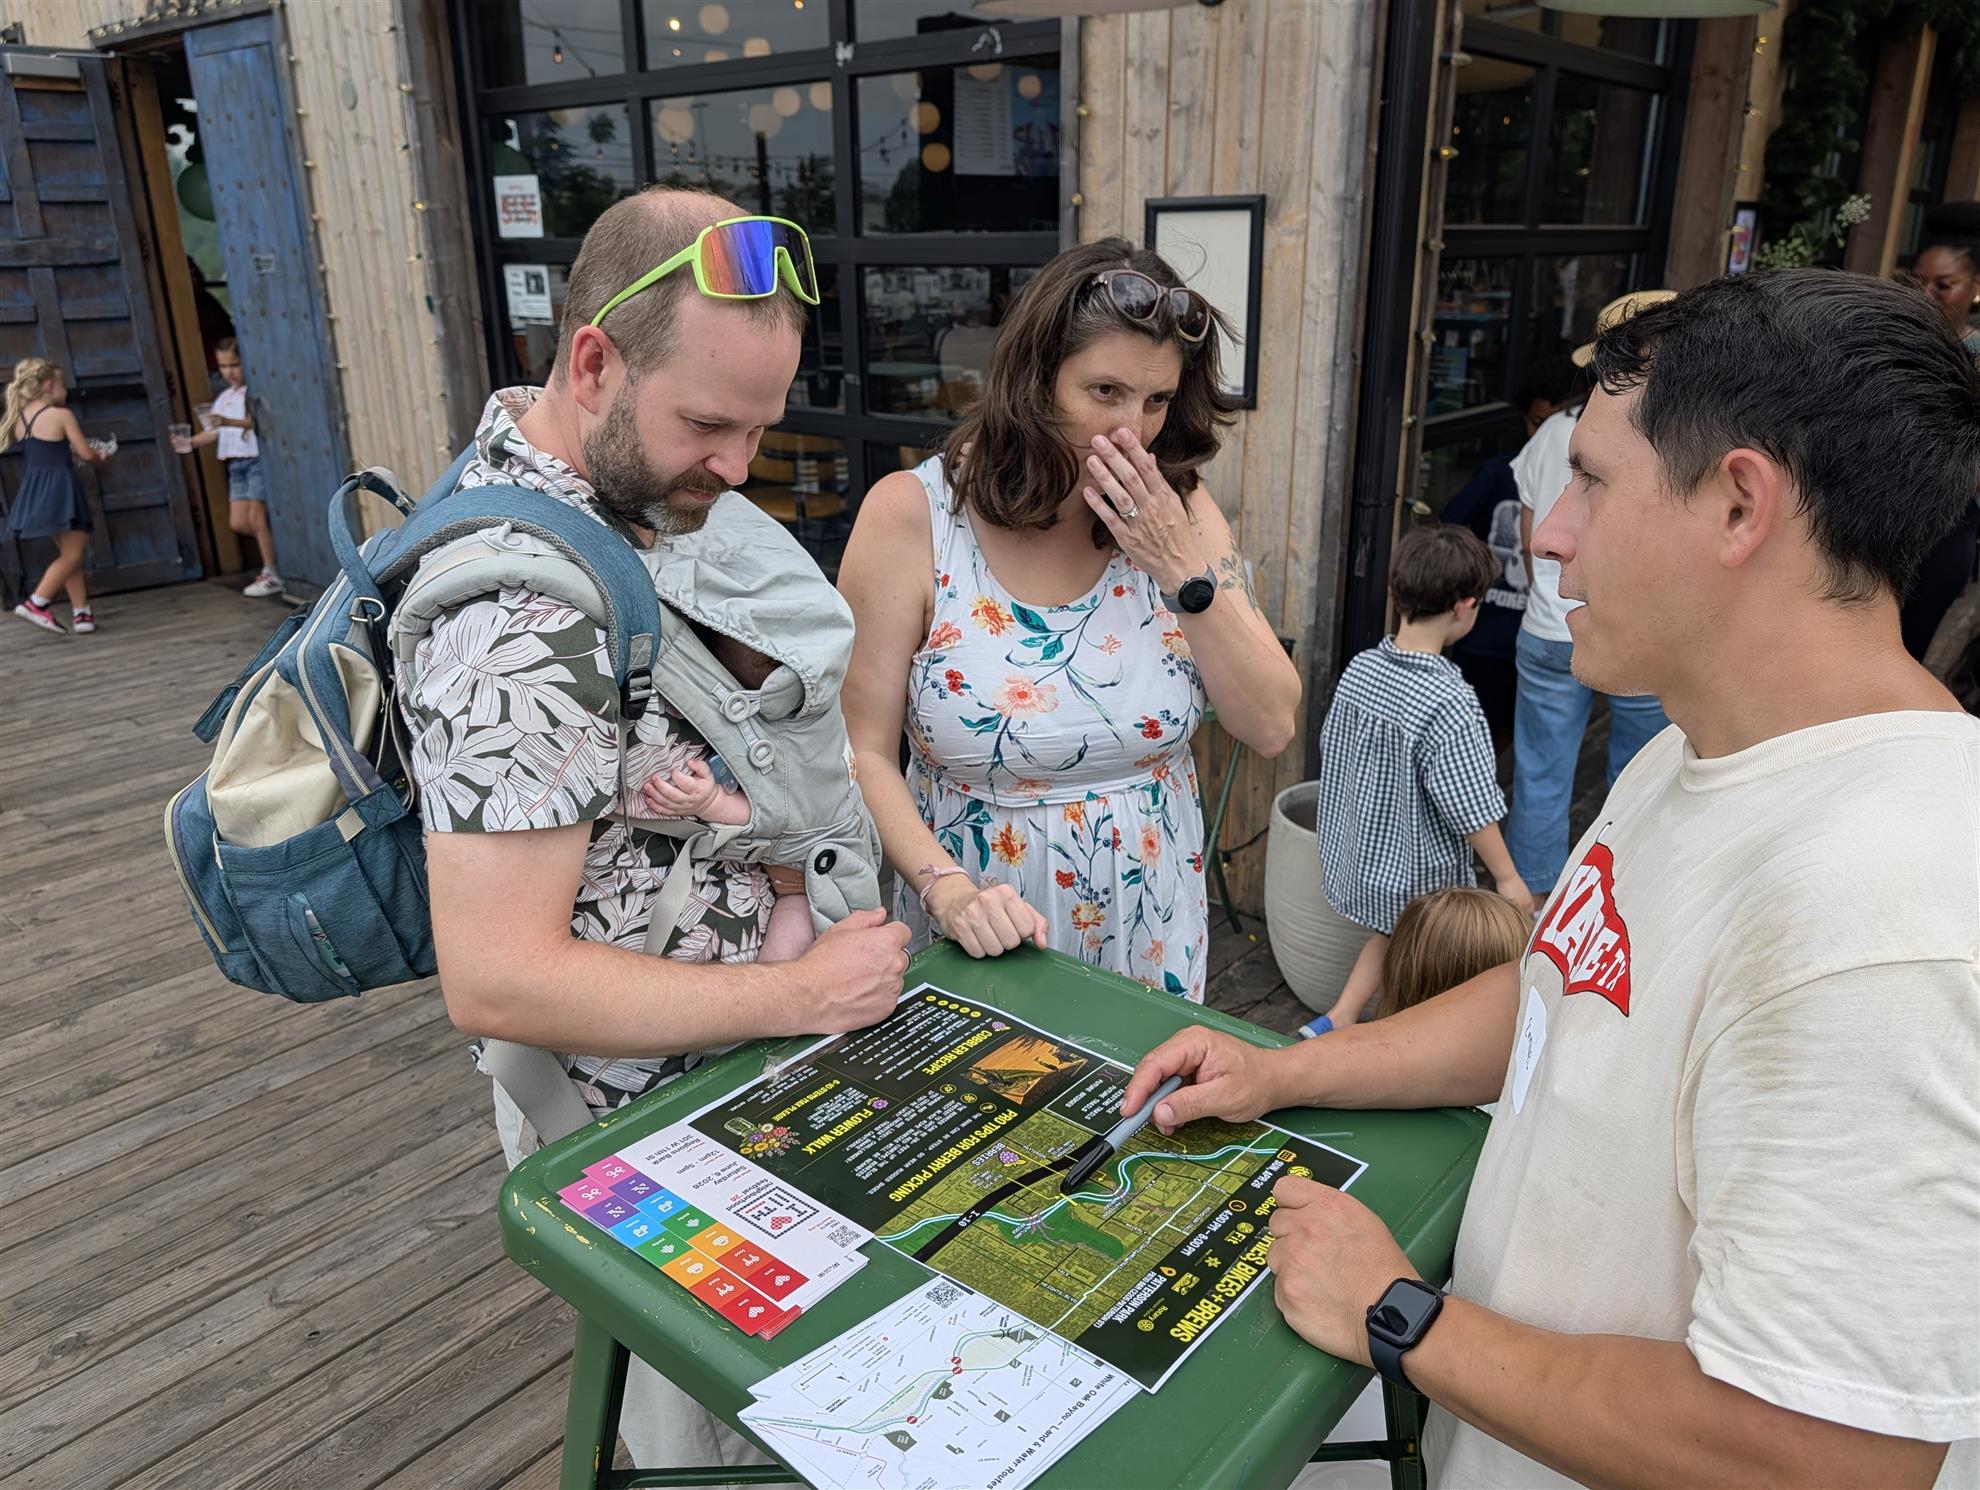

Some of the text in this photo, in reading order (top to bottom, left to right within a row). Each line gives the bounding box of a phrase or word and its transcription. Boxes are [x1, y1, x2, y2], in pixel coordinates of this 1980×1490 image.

[949, 1029, 994, 1055] COBBLER
[920, 1052, 959, 1075] RECIPE
[804, 1086, 829, 1100] STEMS
[1062, 1078, 1104, 1107] FUTURE BRIDGES
[1079, 1084, 1118, 1112] FUTURE TRAILS
[793, 1097, 811, 1107] MAX
[1082, 1088, 1126, 1120] EXISTING TRAILS
[769, 1105, 798, 1121] PLEASE
[799, 1108, 875, 1155] FLOWER WALK
[650, 1137, 701, 1165] Regions Bank
[653, 1146, 671, 1156] 11th
[697, 1148, 720, 1162] 12pm
[884, 1108, 1019, 1202] PRO TIPS FOR BERRY PICKING
[970, 1142, 1006, 1166] BERRIES
[675, 1162, 695, 1175] 5pm
[712, 1164, 747, 1186] Saturday
[719, 1160, 739, 1173] June
[1255, 1169, 1274, 1182] APR
[691, 1175, 714, 1189] 2026
[741, 1177, 769, 1194] festival
[1249, 1179, 1264, 1189] 26
[724, 1180, 773, 1211] neighborhood
[955, 1209, 981, 1227] I-10
[1213, 1208, 1234, 1224] 4:00
[1206, 1220, 1222, 1231] PM
[1188, 1232, 1209, 1248] 8:00
[1225, 1231, 1247, 1246] Fit
[1179, 1245, 1196, 1256] PM
[1211, 1260, 1260, 1298] BIKES
[1127, 1274, 1167, 1308] PATTERSON
[1111, 1304, 1135, 1324] PARK
[1146, 1303, 1169, 1322] Rotary
[1167, 1297, 1222, 1343] BREWS
[1093, 1373, 1114, 1390] White
[1081, 1389, 1097, 1402] Oak
[1059, 1401, 1085, 1421] Bayou
[1036, 1424, 1059, 1442] Land
[1031, 1440, 1043, 1448] &
[1009, 1446, 1036, 1467] Water
[984, 1465, 1015, 1490] Routes
